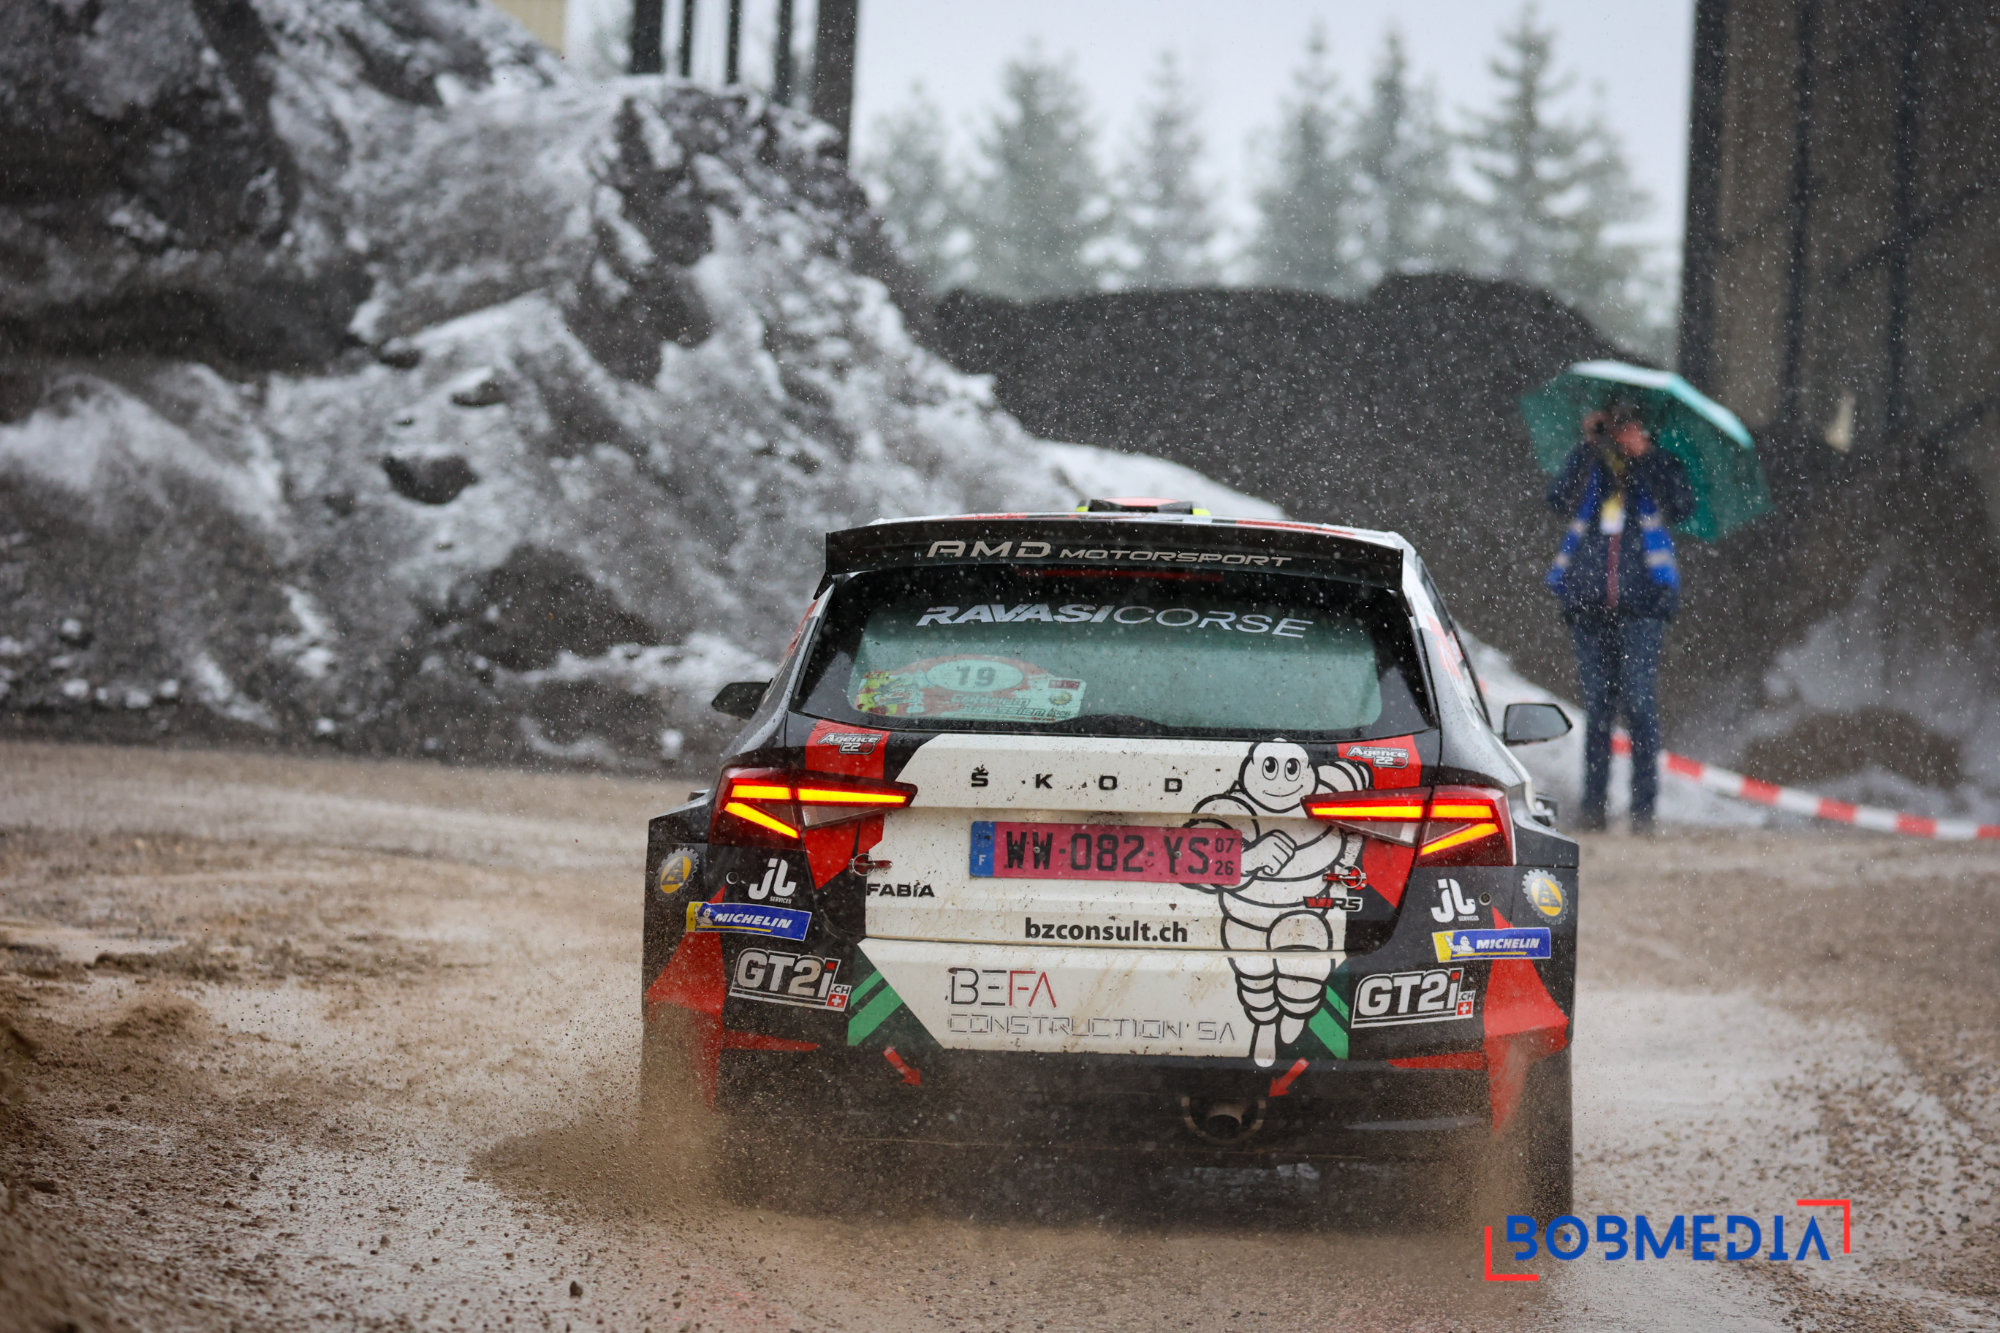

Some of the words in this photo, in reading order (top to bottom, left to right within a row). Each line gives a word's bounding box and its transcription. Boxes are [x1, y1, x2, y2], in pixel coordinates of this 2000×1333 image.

[927, 540, 1051, 560] AMD
[1059, 548, 1293, 568] MOTORSPORT
[956, 665, 997, 687] 19
[817, 734, 879, 745] Agence
[1215, 837, 1234, 854] 07
[978, 854, 987, 866] F
[1214, 860, 1234, 876] 26
[866, 883, 935, 898] FABIA
[714, 913, 793, 929] MICHELIN
[1025, 916, 1188, 943] bzconsult.ch
[1476, 938, 1540, 950] MICHELIN
[951, 967, 1057, 1008] BEFA
